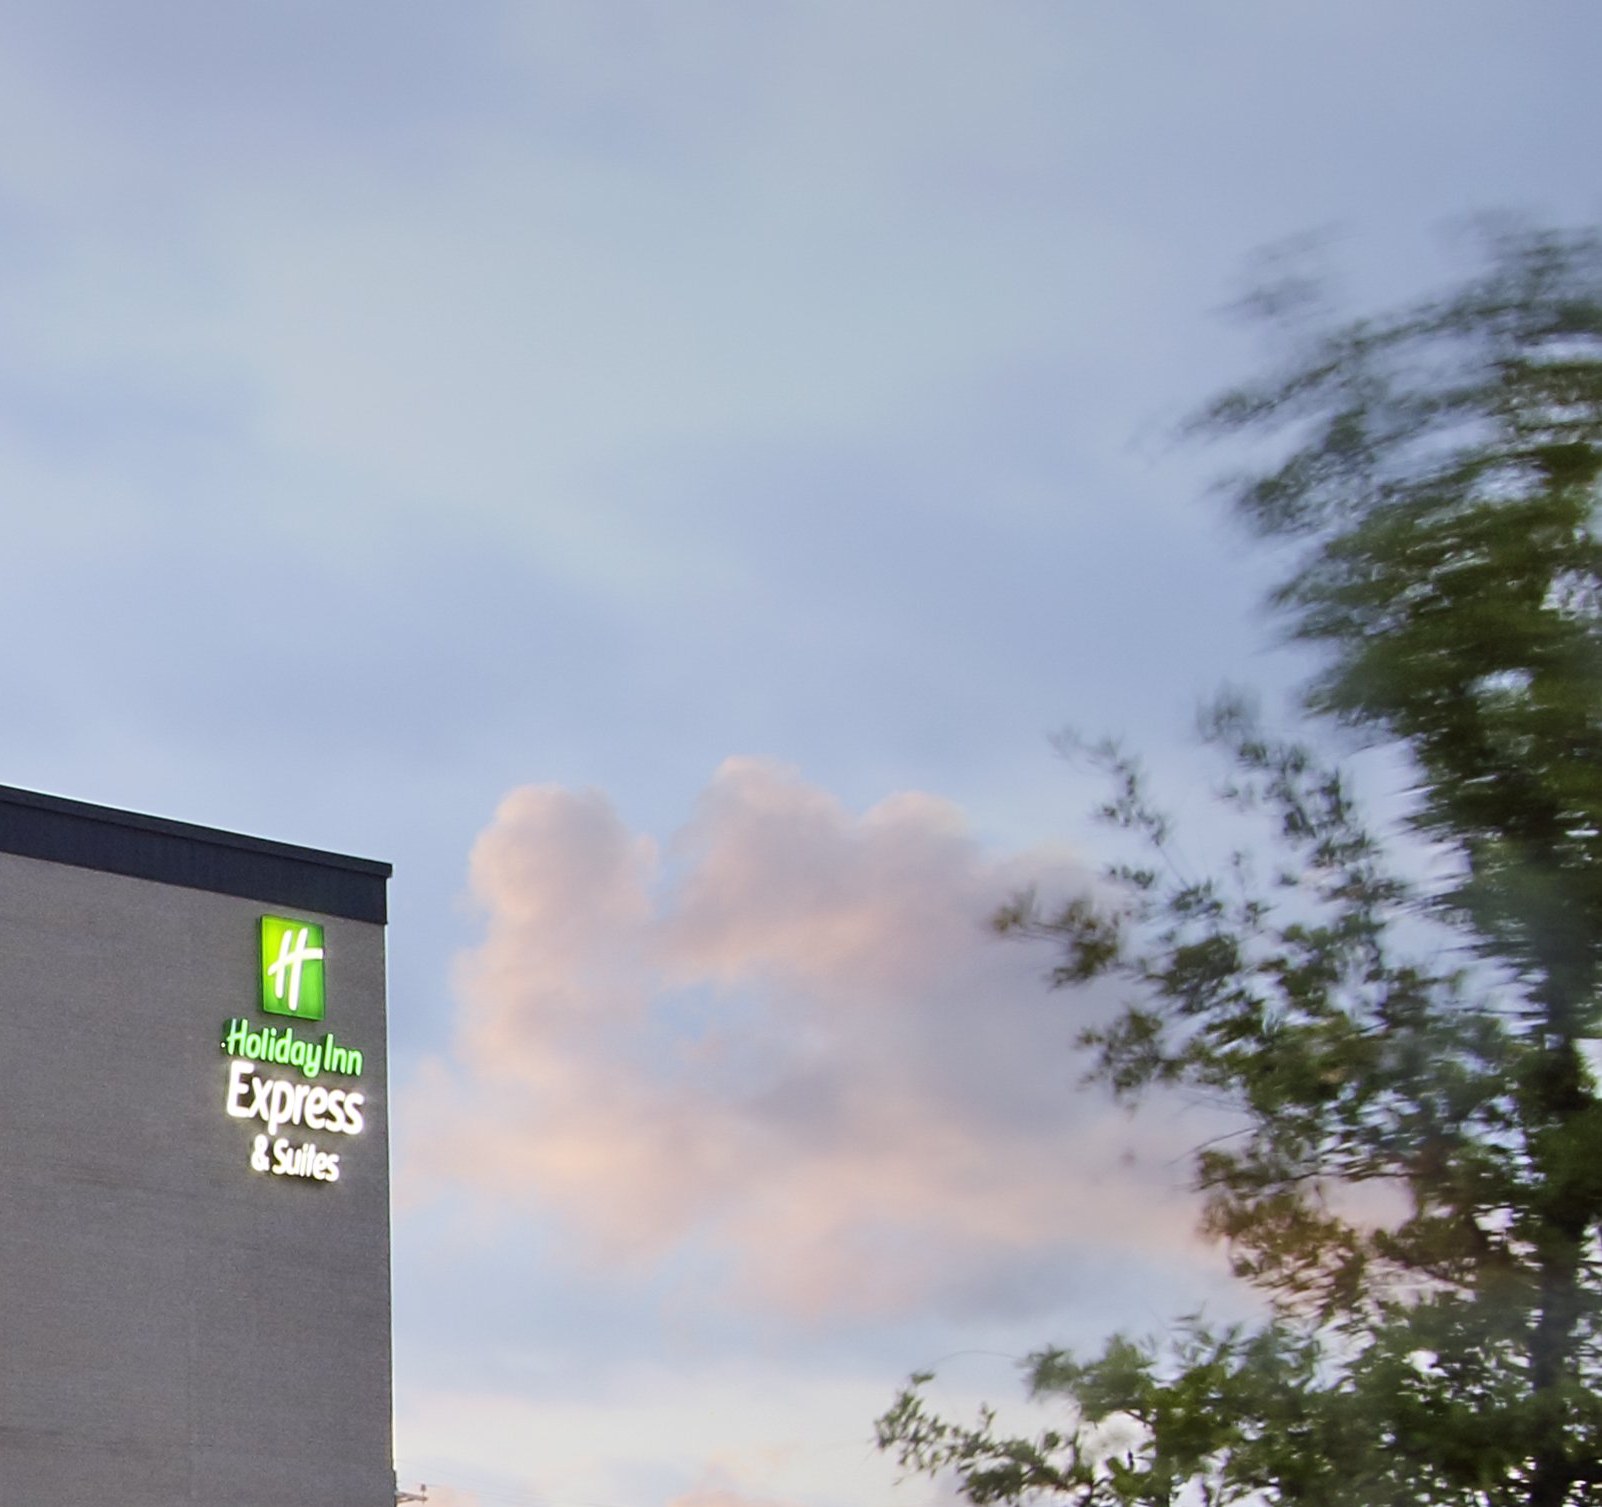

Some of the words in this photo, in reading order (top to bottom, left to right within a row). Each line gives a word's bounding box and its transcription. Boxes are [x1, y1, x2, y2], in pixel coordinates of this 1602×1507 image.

[227, 1018, 322, 1078] Holiday
[324, 1033, 363, 1076] Inn
[226, 1060, 365, 1136] Express
[251, 1133, 270, 1172] &
[273, 1138, 340, 1182] Suites
